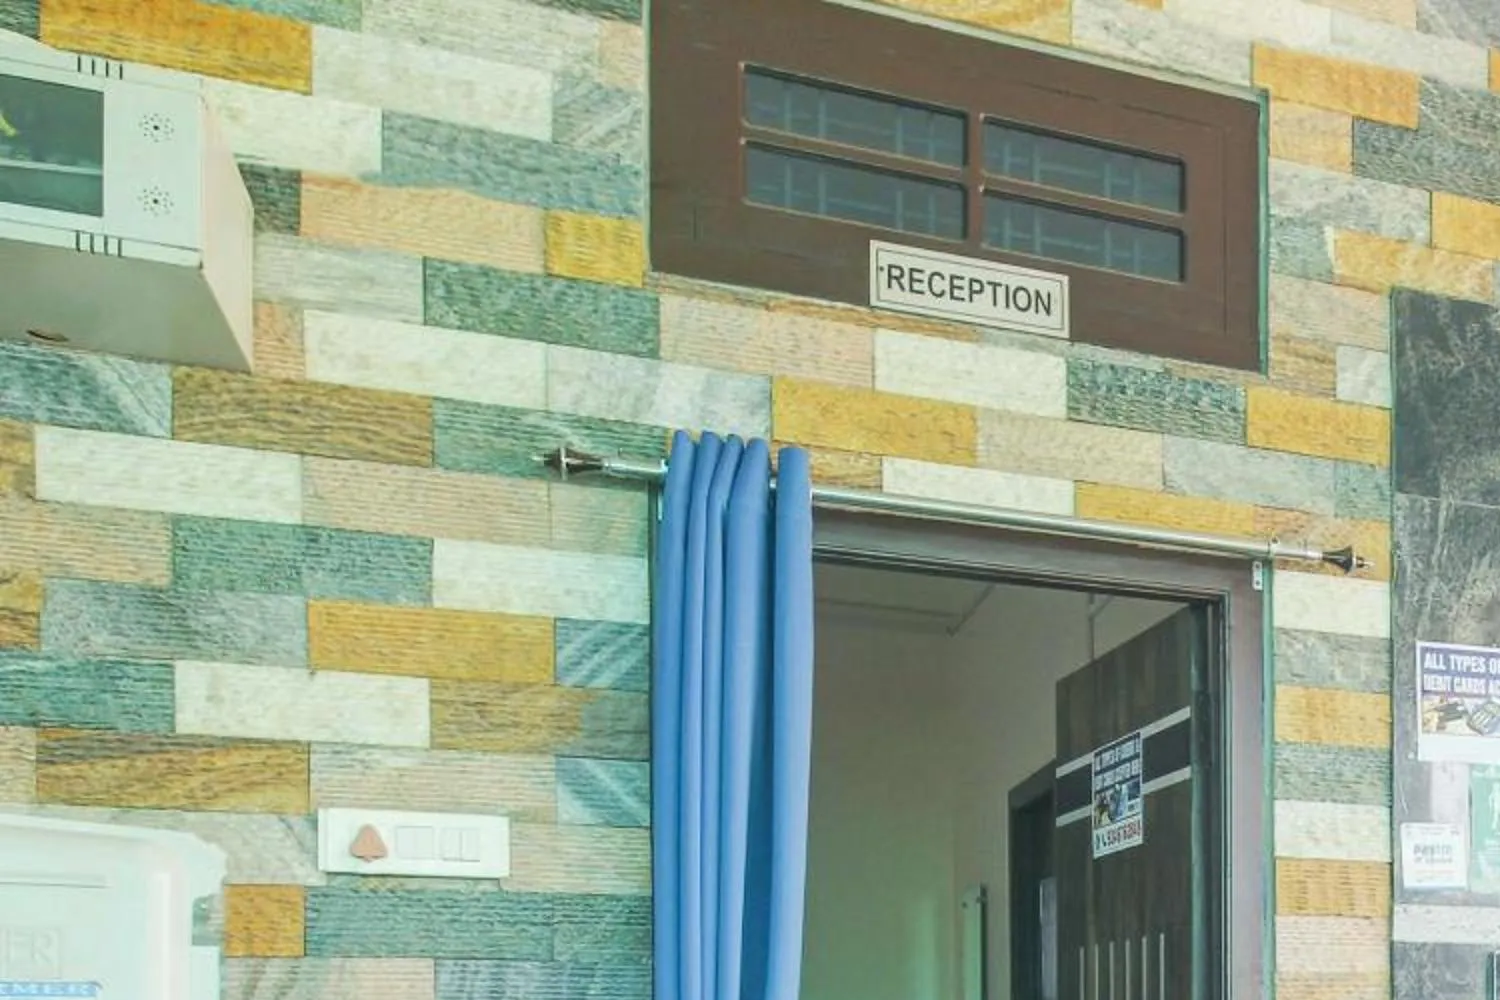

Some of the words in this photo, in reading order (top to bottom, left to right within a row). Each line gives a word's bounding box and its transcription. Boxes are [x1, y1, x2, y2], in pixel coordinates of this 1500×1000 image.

[887, 263, 1051, 316] RECEPTION
[1423, 652, 1447, 671] ALL
[1450, 654, 1487, 674] TYPES
